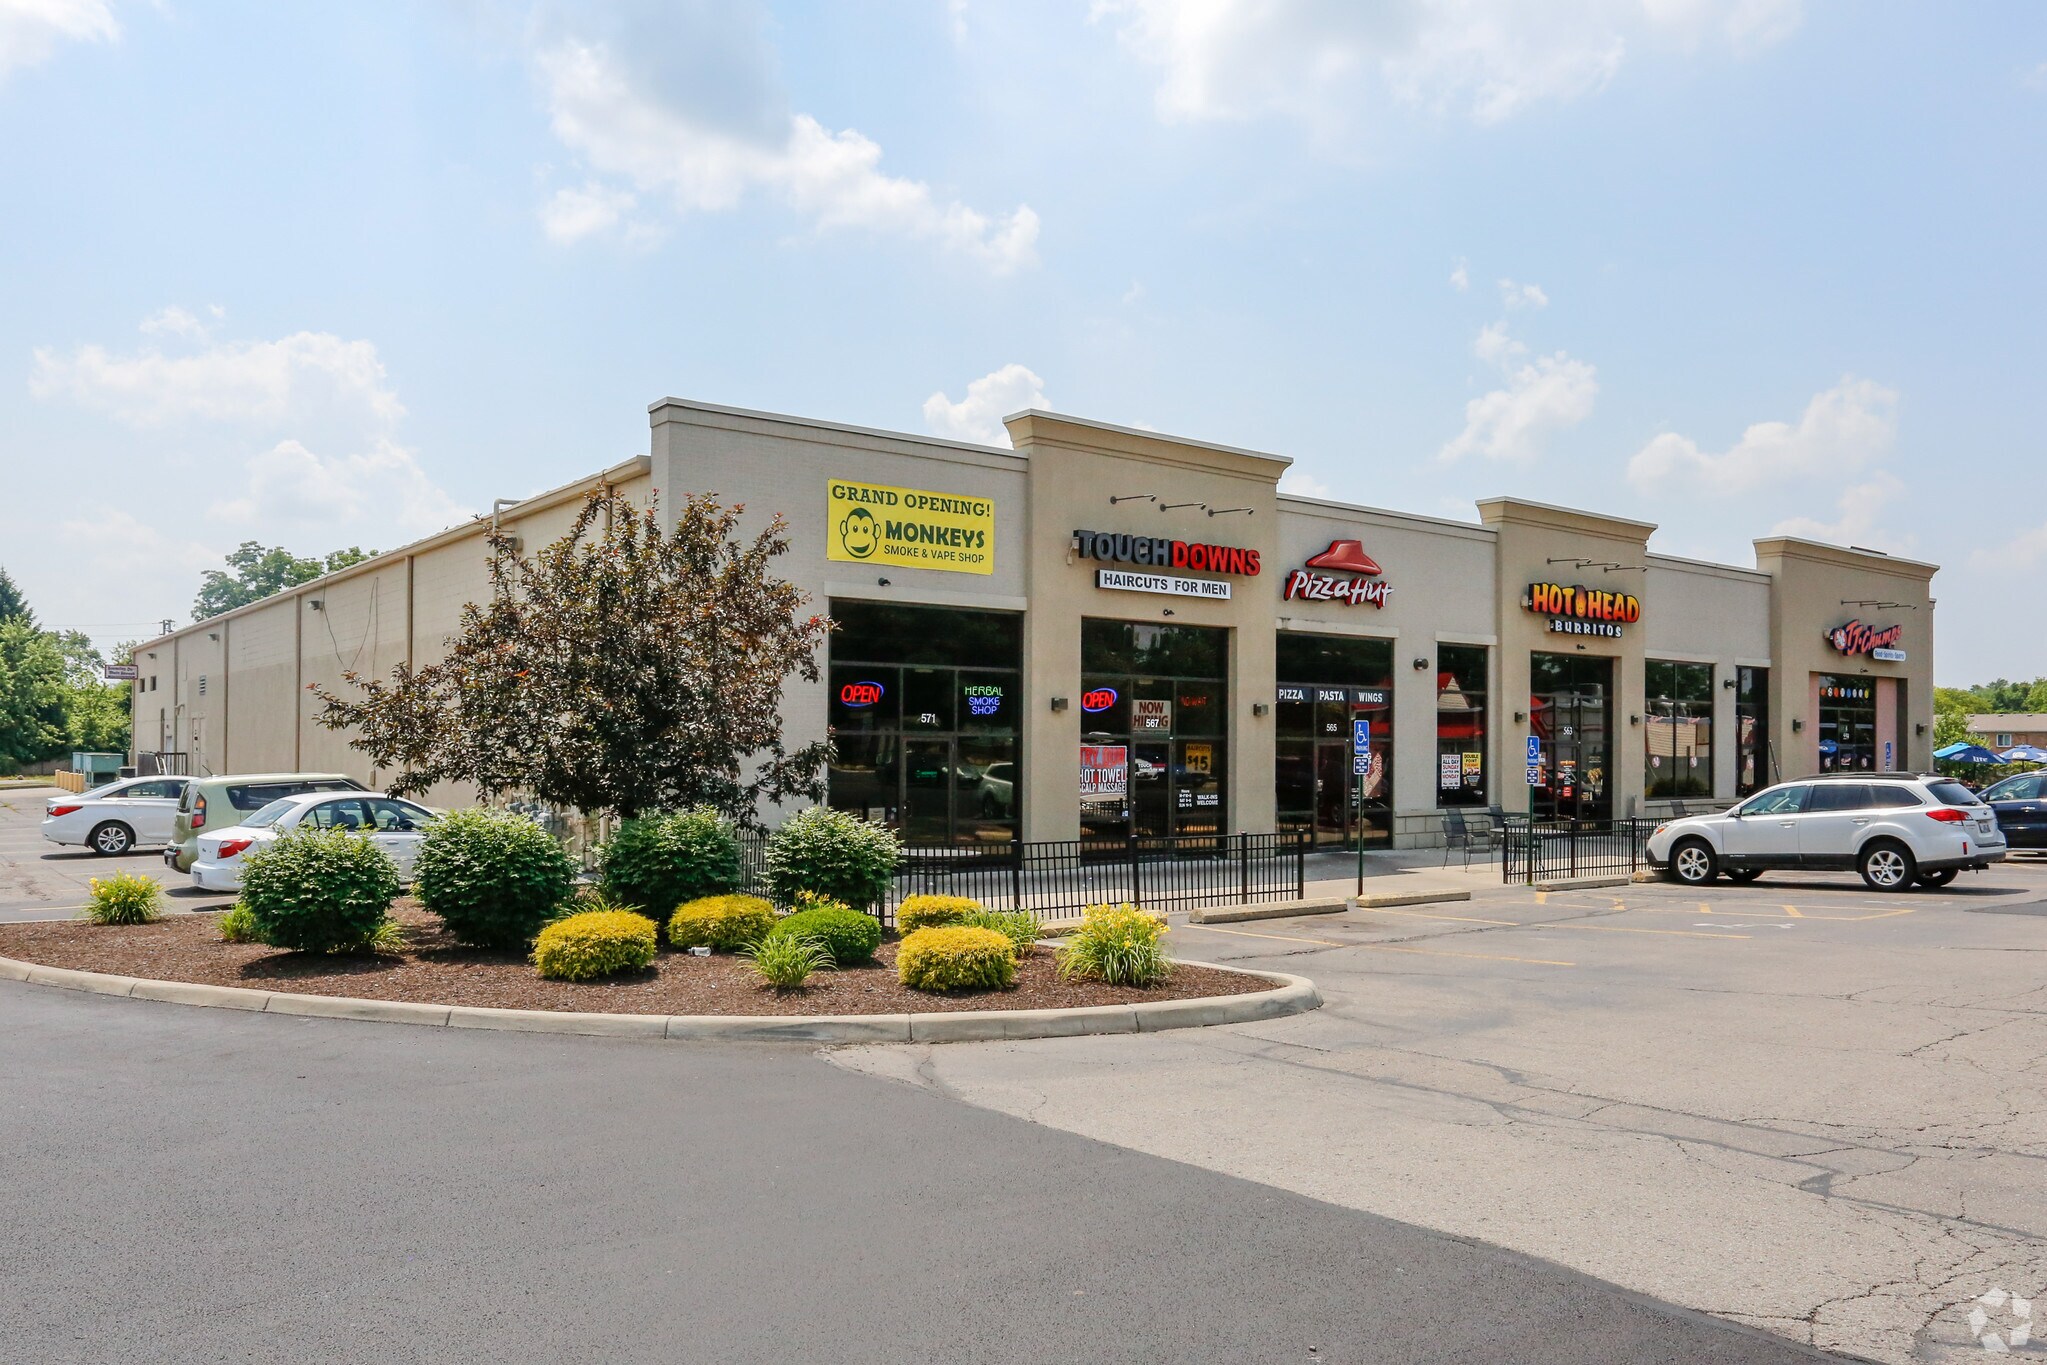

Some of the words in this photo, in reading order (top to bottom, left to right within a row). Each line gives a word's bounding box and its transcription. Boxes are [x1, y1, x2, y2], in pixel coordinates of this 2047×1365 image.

[832, 485, 898, 506] GRAND
[904, 494, 990, 517] OPENING!
[885, 520, 985, 549] MONKEYS
[884, 544, 919, 558] SMOKE
[921, 549, 928, 558] &
[930, 550, 956, 561] VAPE
[958, 551, 985, 563] SHOP
[1075, 530, 1261, 576] TOUCHDOWNS
[1104, 573, 1168, 590] HAIRCUTS
[1174, 580, 1198, 593] FOR
[1201, 583, 1227, 596] MEN
[1287, 570, 1351, 600] Pizza
[1348, 578, 1395, 608] Hut
[1532, 583, 1575, 616] HOT
[1587, 590, 1640, 623] HEAD
[1554, 619, 1622, 638] BURRITOS
[841, 684, 880, 703] OPEN
[965, 686, 1003, 697] HERBAL
[1278, 689, 1304, 700] PIZZA
[1319, 690, 1344, 701] PASTA
[1358, 692, 1383, 702] WINGS
[968, 697, 1000, 706] SMOKE
[1083, 692, 1113, 708] OPEN
[971, 706, 997, 715] SHOP
[1138, 701, 1164, 713] NOW
[921, 713, 936, 723] 571
[1146, 718, 1159, 728] 567
[1326, 723, 1337, 732] 565
[1563, 726, 1573, 735] 563
[1187, 755, 1208, 771] $15
[1097, 768, 1126, 783] TOWEL
[1098, 783, 1126, 793] MASSAGE
